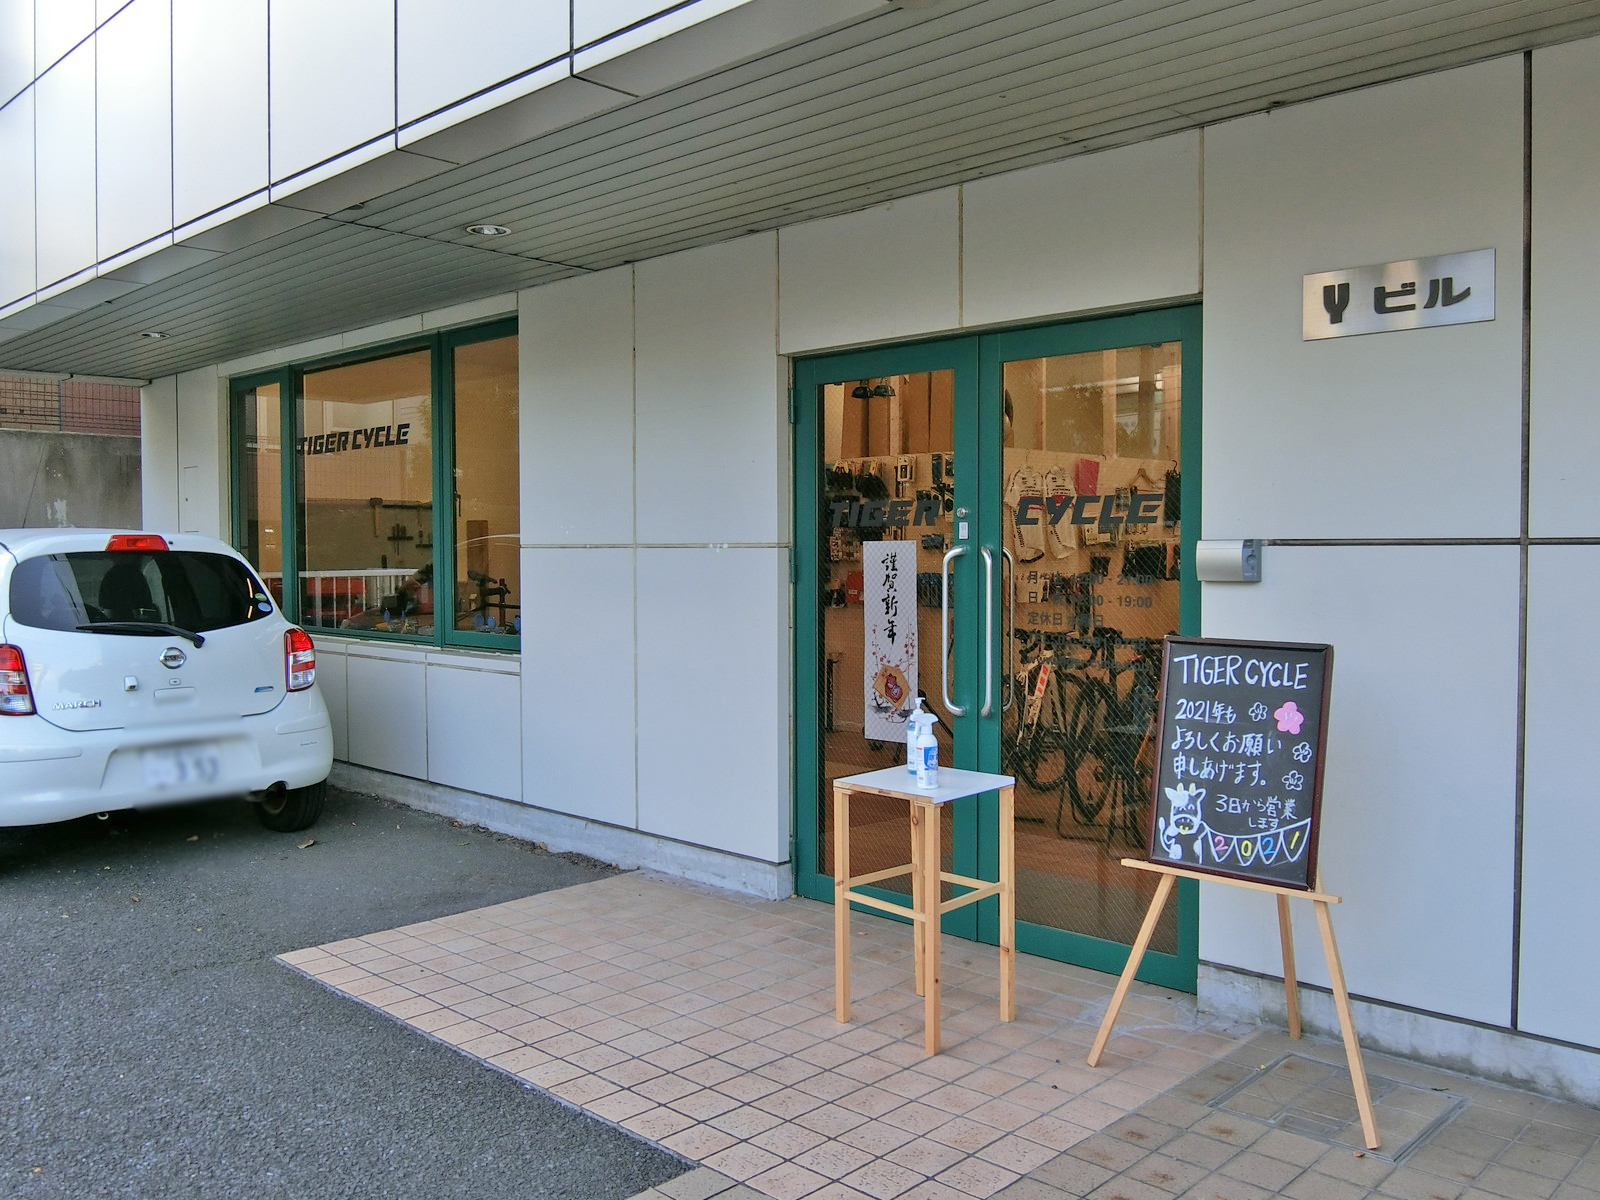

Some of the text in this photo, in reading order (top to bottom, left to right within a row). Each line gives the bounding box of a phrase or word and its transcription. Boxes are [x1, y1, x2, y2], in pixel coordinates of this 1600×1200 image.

[297, 423, 410, 456] TIGER CYCLE
[829, 493, 1163, 528] TIGER CYCLE
[881, 552, 899, 645] 謹賀新年
[1117, 596, 1154, 608] 19:00
[1027, 612, 1063, 626] 定休日
[1173, 654, 1243, 685] TIGER
[1245, 659, 1309, 689] CYCLE
[52, 700, 101, 710] MARCH
[1174, 699, 1237, 724] 2021年も
[1171, 725, 1282, 756] よろしくお願い
[1173, 752, 1267, 786] 申しあげます。
[1215, 794, 1298, 820] 3日から営業
[1248, 817, 1280, 831] します
